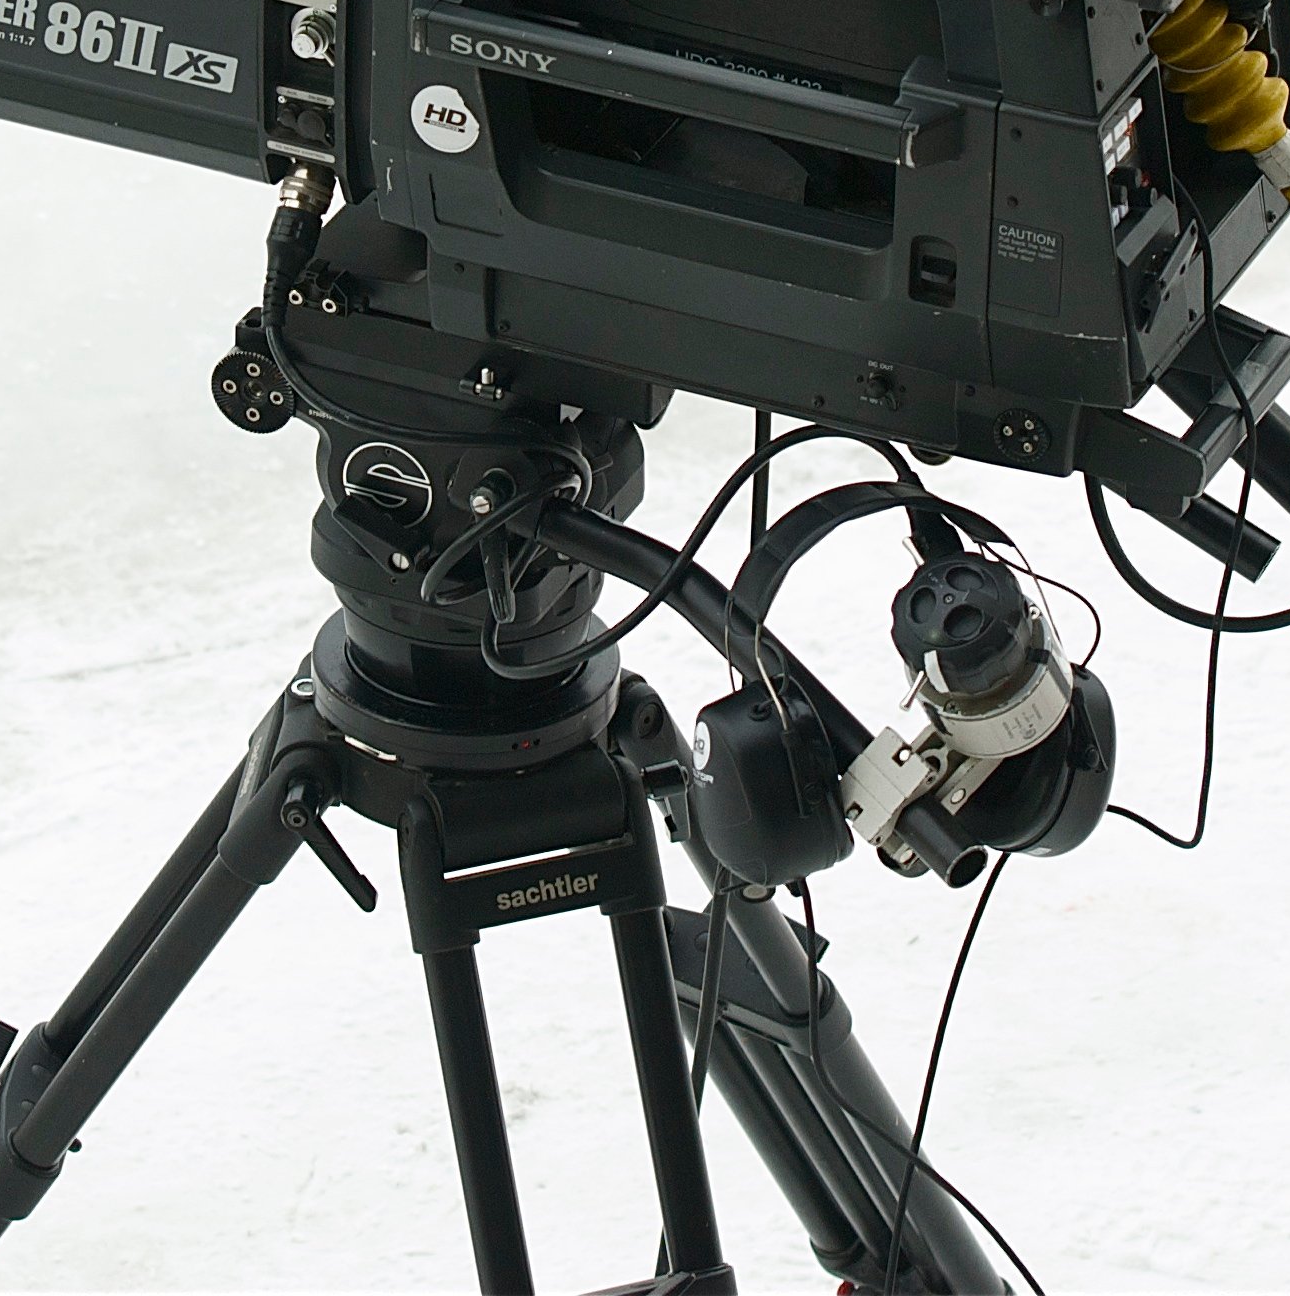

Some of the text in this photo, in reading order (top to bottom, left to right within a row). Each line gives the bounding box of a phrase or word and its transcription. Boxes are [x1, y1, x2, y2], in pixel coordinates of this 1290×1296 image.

[8, 32, 36, 47] 1:1.7
[450, 33, 557, 74] SONY
[168, 50, 228, 85] XS
[425, 102, 467, 127] HD
[998, 224, 1056, 247] CAUTION
[496, 872, 600, 911] sachtler
